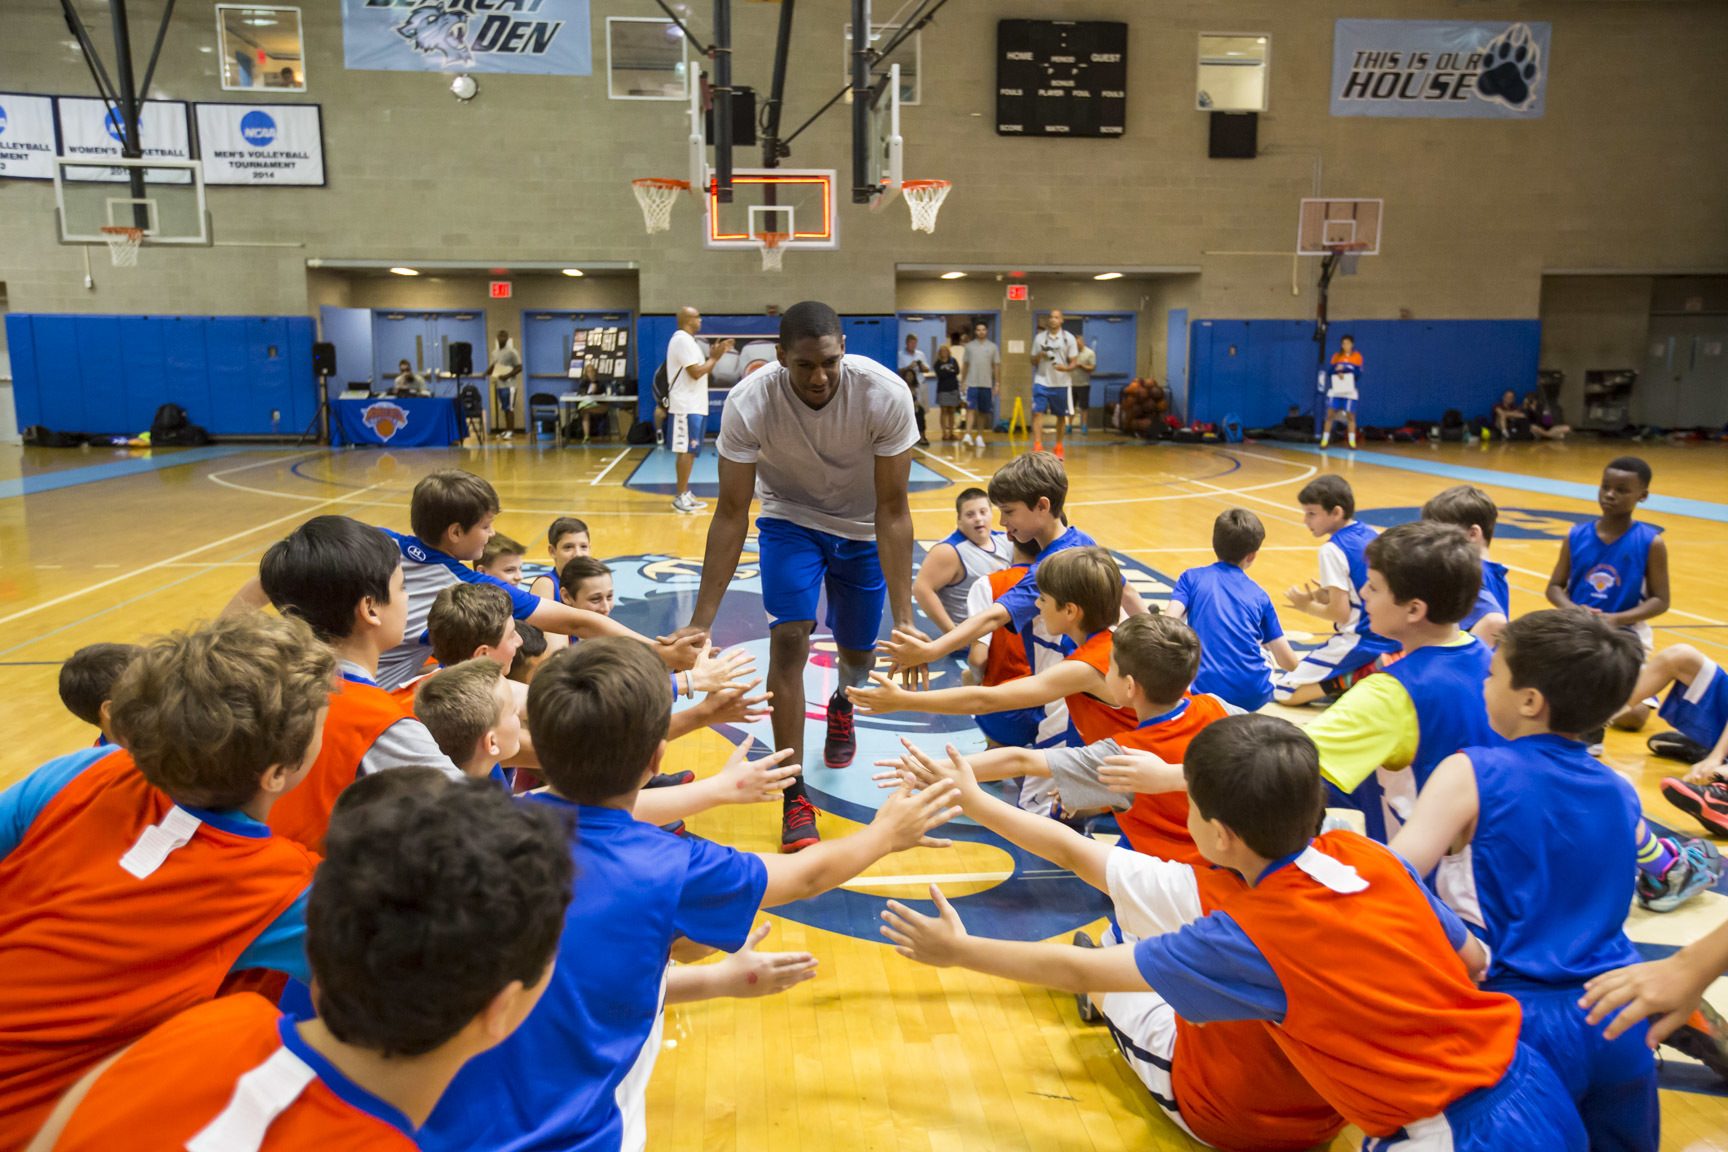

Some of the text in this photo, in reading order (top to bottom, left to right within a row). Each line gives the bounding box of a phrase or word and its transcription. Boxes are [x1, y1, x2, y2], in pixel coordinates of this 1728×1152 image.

[470, 14, 564, 54] DEN
[1006, 51, 1034, 60] HOME
[1090, 53, 1122, 62] GUEST
[1353, 51, 1401, 69] THIS
[1407, 52, 1430, 70] IS
[1341, 72, 1478, 101] HOUSE
[244, 127, 277, 139] NCAA
[68, 146, 118, 155] WOMEN'S
[214, 151, 310, 159] MEN'S VOLLEYBALL
[492, 283, 510, 297] EXIT
[1009, 286, 1027, 300] EXIT
